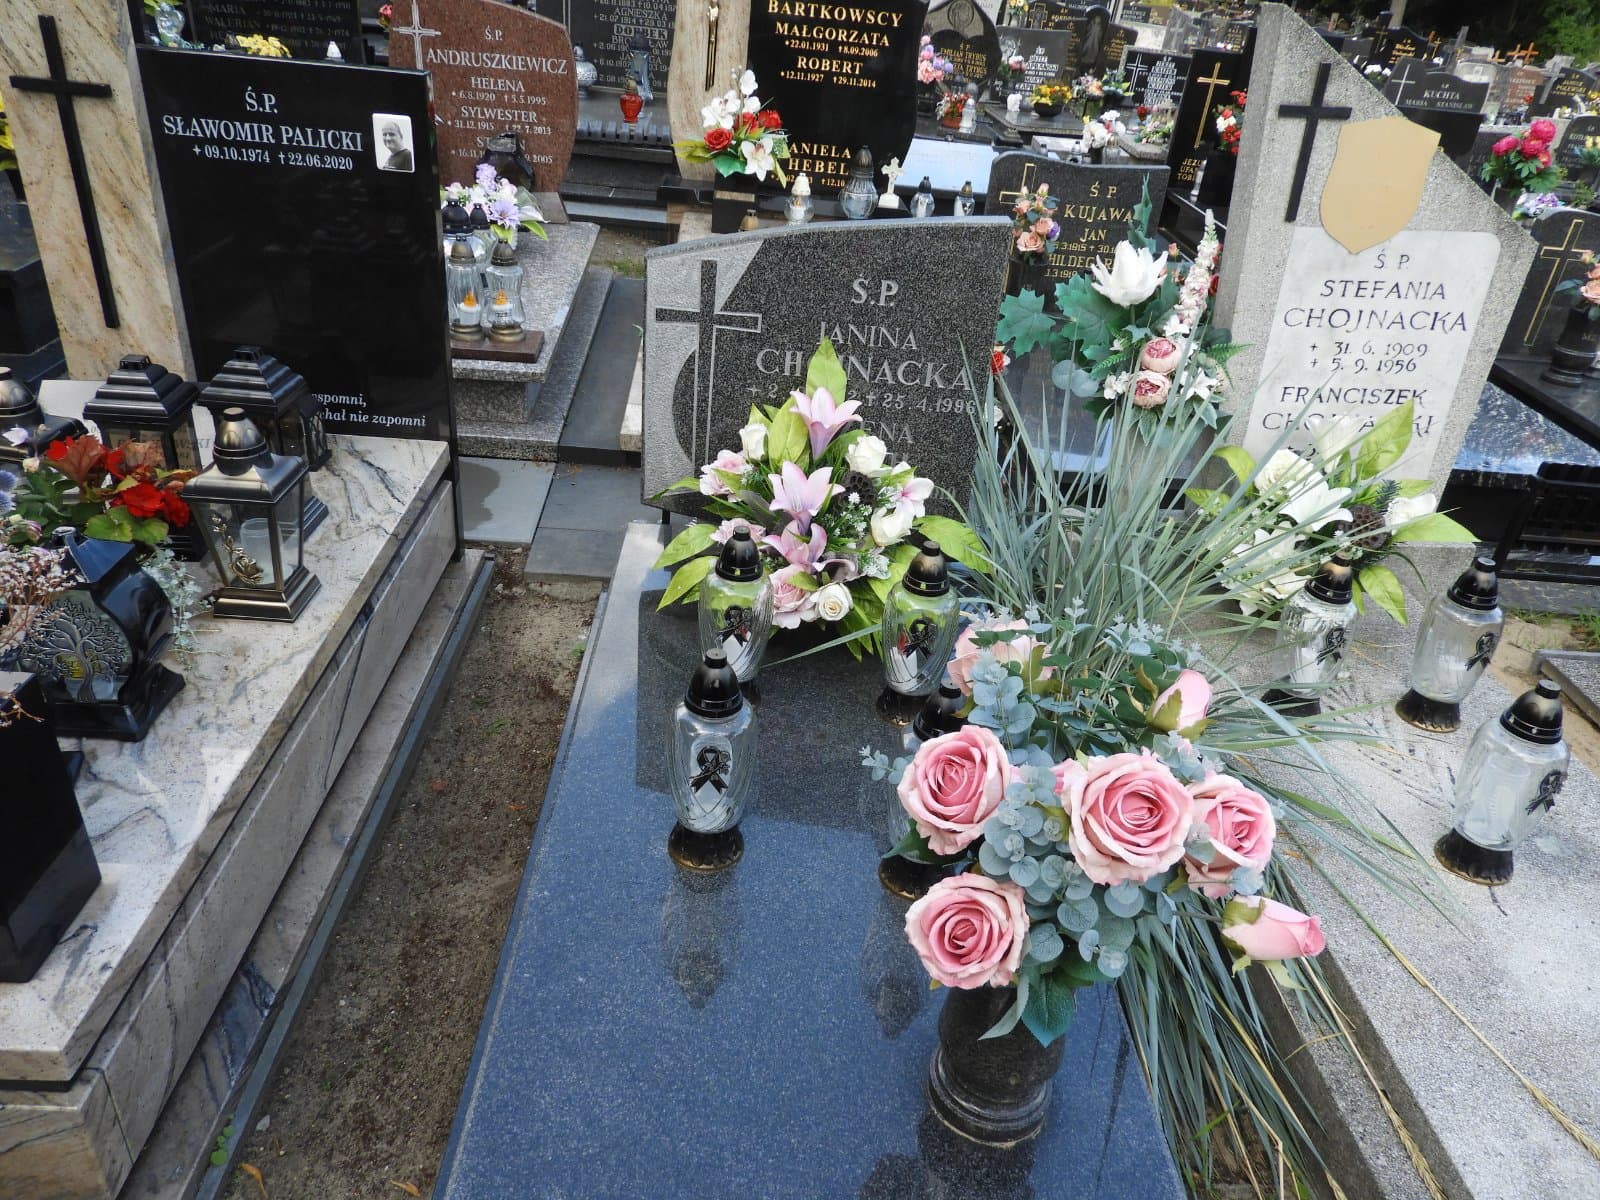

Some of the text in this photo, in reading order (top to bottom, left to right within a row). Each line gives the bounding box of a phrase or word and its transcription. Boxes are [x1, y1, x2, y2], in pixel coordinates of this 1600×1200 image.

[614, 7, 668, 21] AGNIESZKA
[768, 0, 903, 27] BARTKOWSCY
[775, 21, 890, 47] MAŁGORZATA
[790, 39, 878, 58] 22.01.1931 8.09.2006
[427, 47, 568, 74] ANDRUSZKIEWICZ
[796, 55, 864, 75] ROBERT
[471, 76, 526, 92] HELENA
[786, 71, 877, 88] 12.11.1927 29.11.2014
[245, 86, 278, 114] Ś.P.
[461, 105, 538, 123] SYLWESTER
[163, 115, 364, 151] SŁAWOMIR PALICKI
[204, 144, 353, 171] 09.10.1974 22.06.2020
[788, 158, 849, 176] HEBEL
[1064, 204, 1133, 223] KUJAWA
[1079, 228, 1108, 242] JAN
[1320, 279, 1446, 300] STEFANIA
[1283, 307, 1467, 334] CHOJNACKA
[816, 321, 918, 350] JANINA
[756, 348, 971, 391] CHNACKA
[1280, 386, 1427, 406] FRANCISZEK
[350, 411, 369, 423] nie
[372, 416, 426, 427] zapomni
